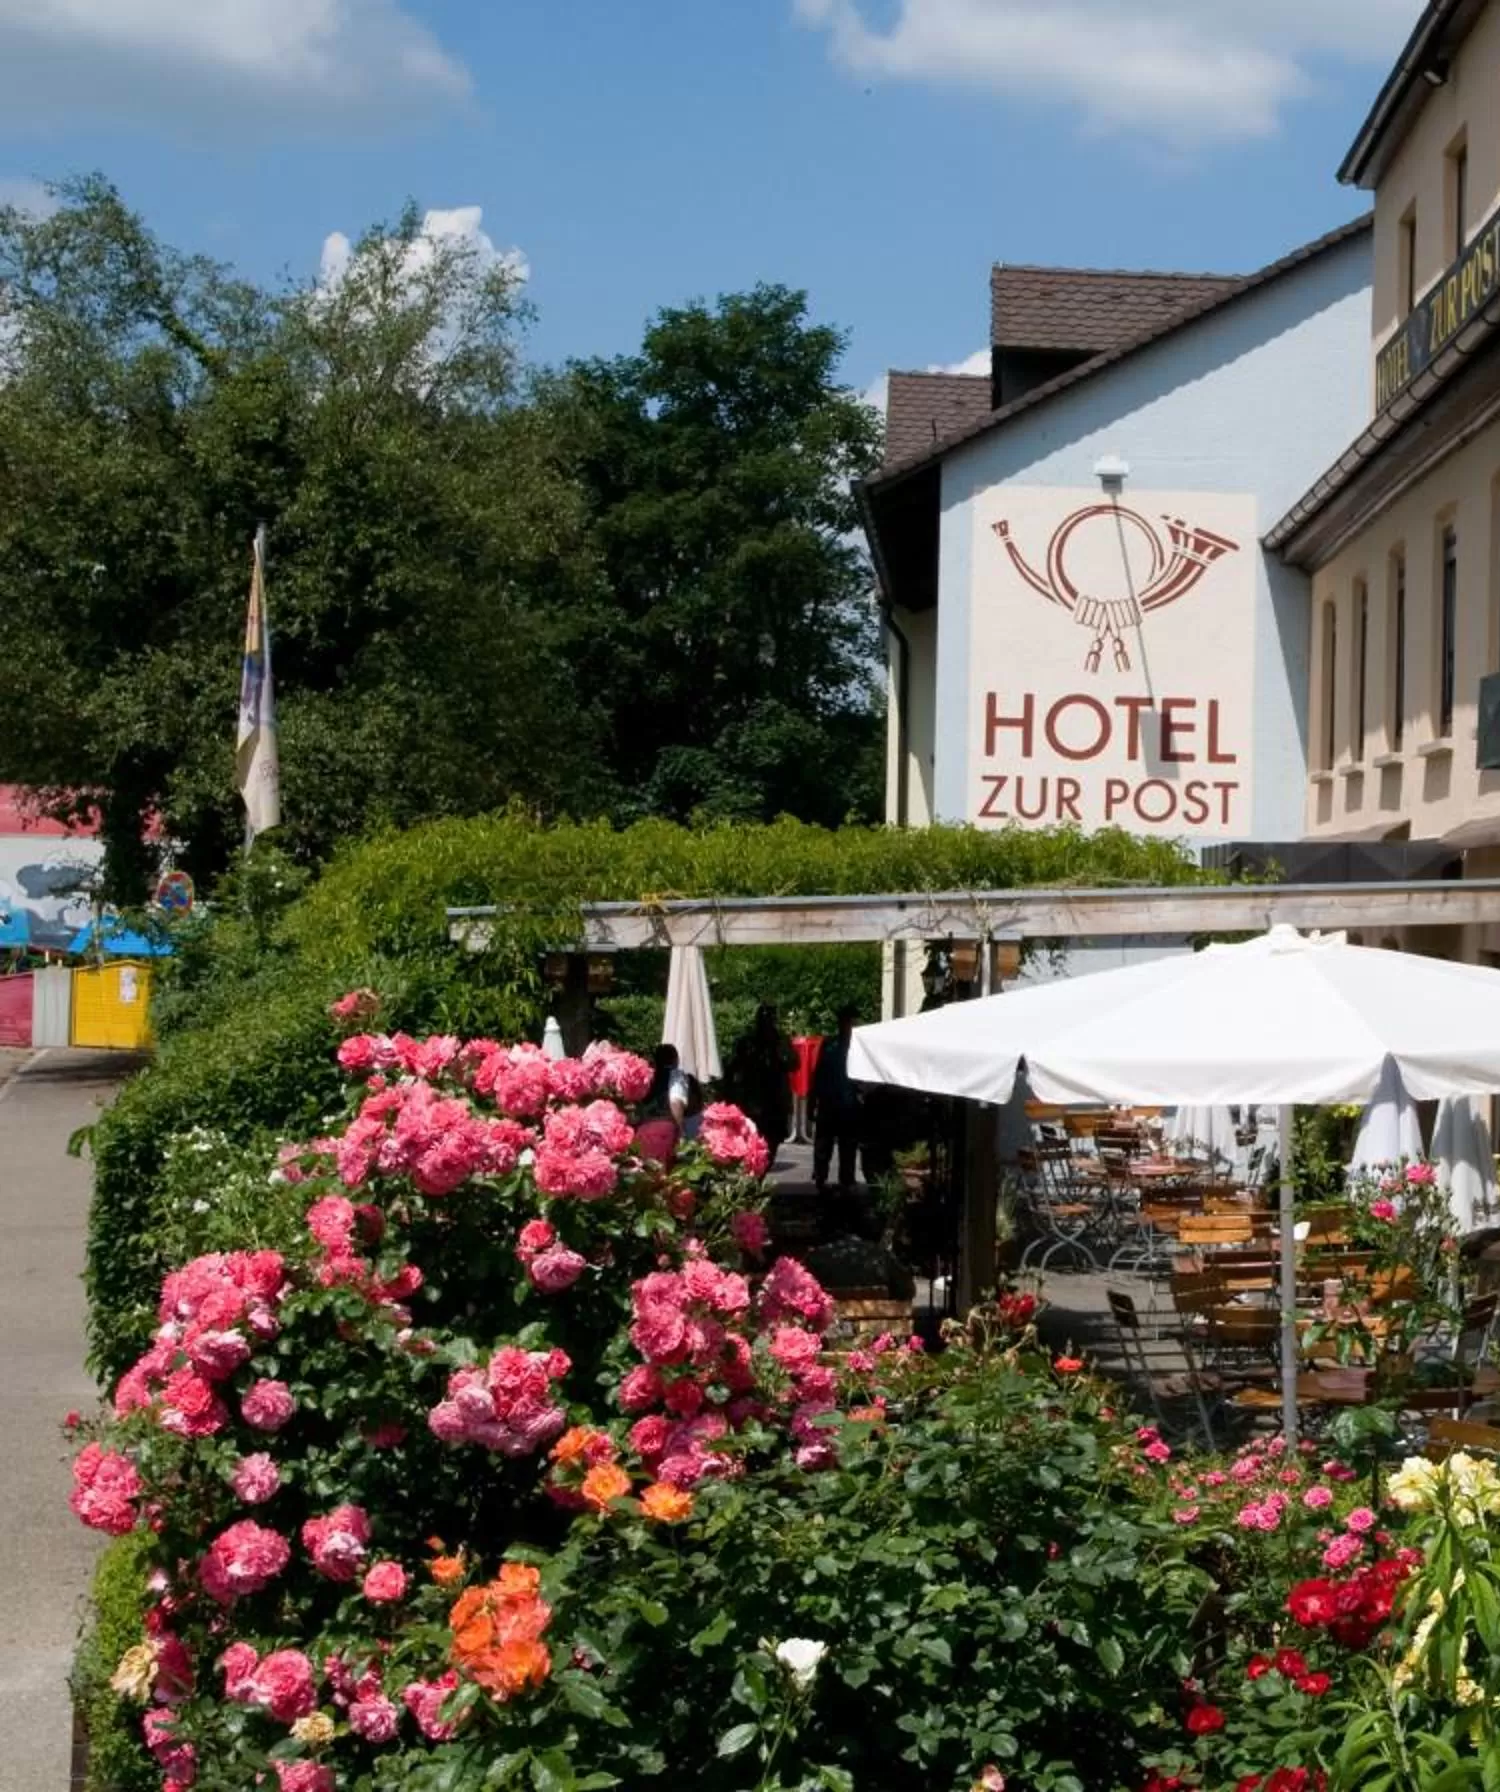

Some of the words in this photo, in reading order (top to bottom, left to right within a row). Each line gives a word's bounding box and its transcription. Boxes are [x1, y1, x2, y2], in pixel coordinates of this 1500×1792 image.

[1429, 274, 1458, 353] ZUR
[984, 691, 1237, 764] HOTEL
[978, 775, 1082, 821] ZUR
[1105, 779, 1239, 825] POST
